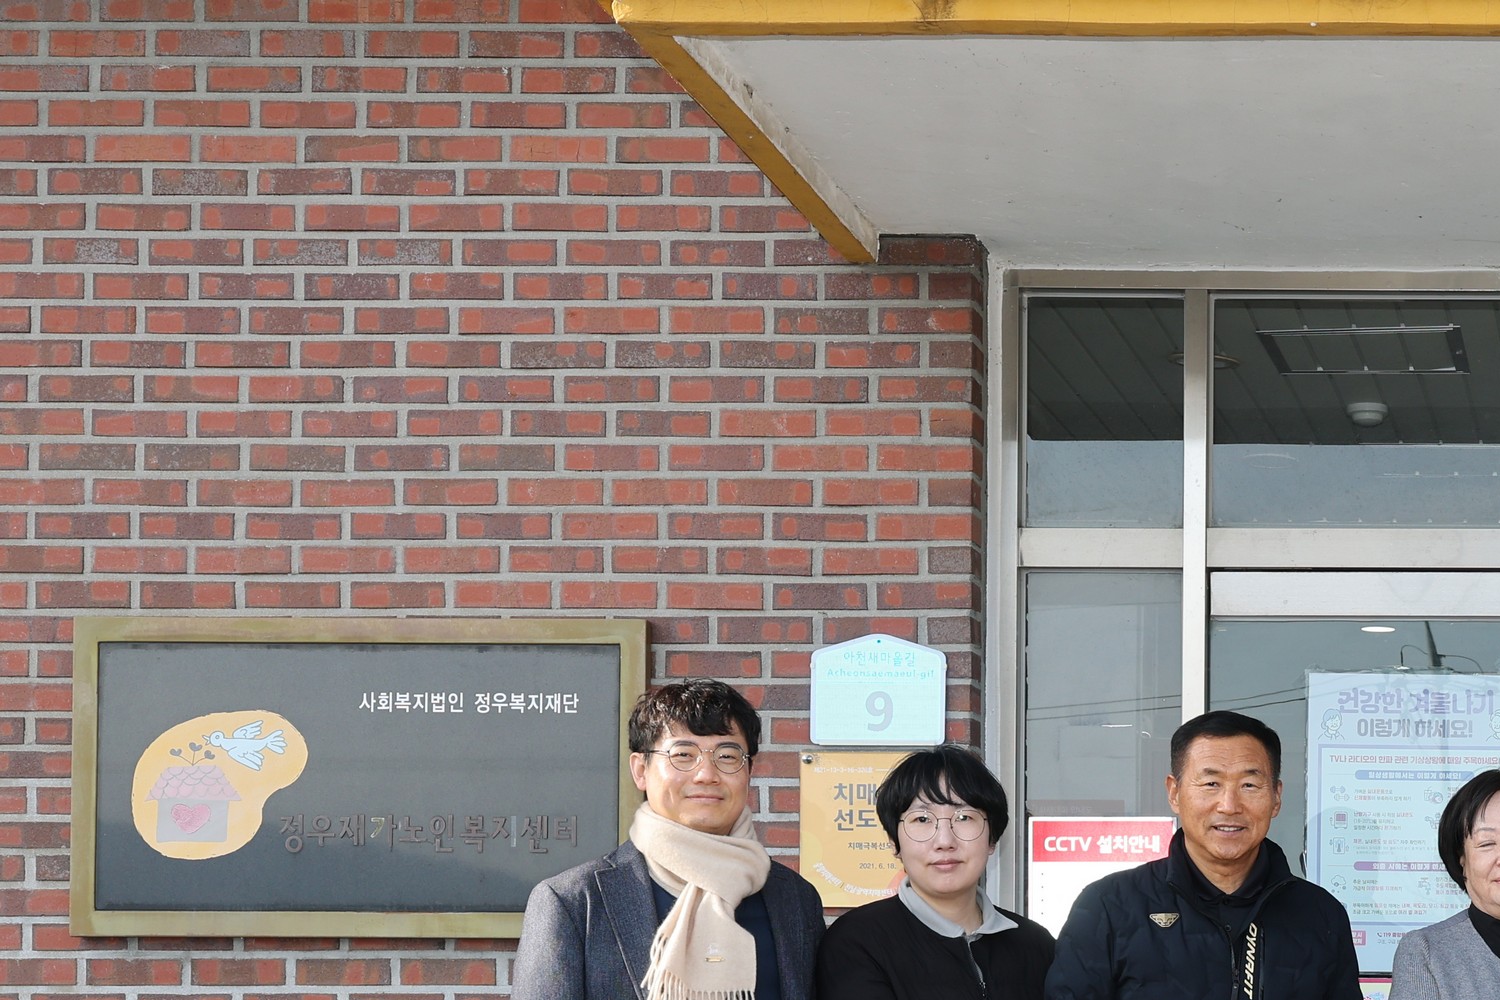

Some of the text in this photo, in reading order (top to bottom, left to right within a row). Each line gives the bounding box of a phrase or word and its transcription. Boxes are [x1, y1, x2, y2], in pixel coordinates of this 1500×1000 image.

[358, 691, 580, 715] 사회복지법인 정우복지재단
[865, 690, 894, 732] 9
[1337, 688, 1495, 714] 건강한 겨울나기
[1357, 718, 1473, 738] 이렇게 하세요!
[833, 783, 877, 805] 치매
[279, 813, 578, 854] 정우재가노인복지센터
[1044, 834, 1161, 854] CCTV 설치안내
[1244, 922, 1258, 1000] DYNAFIT
